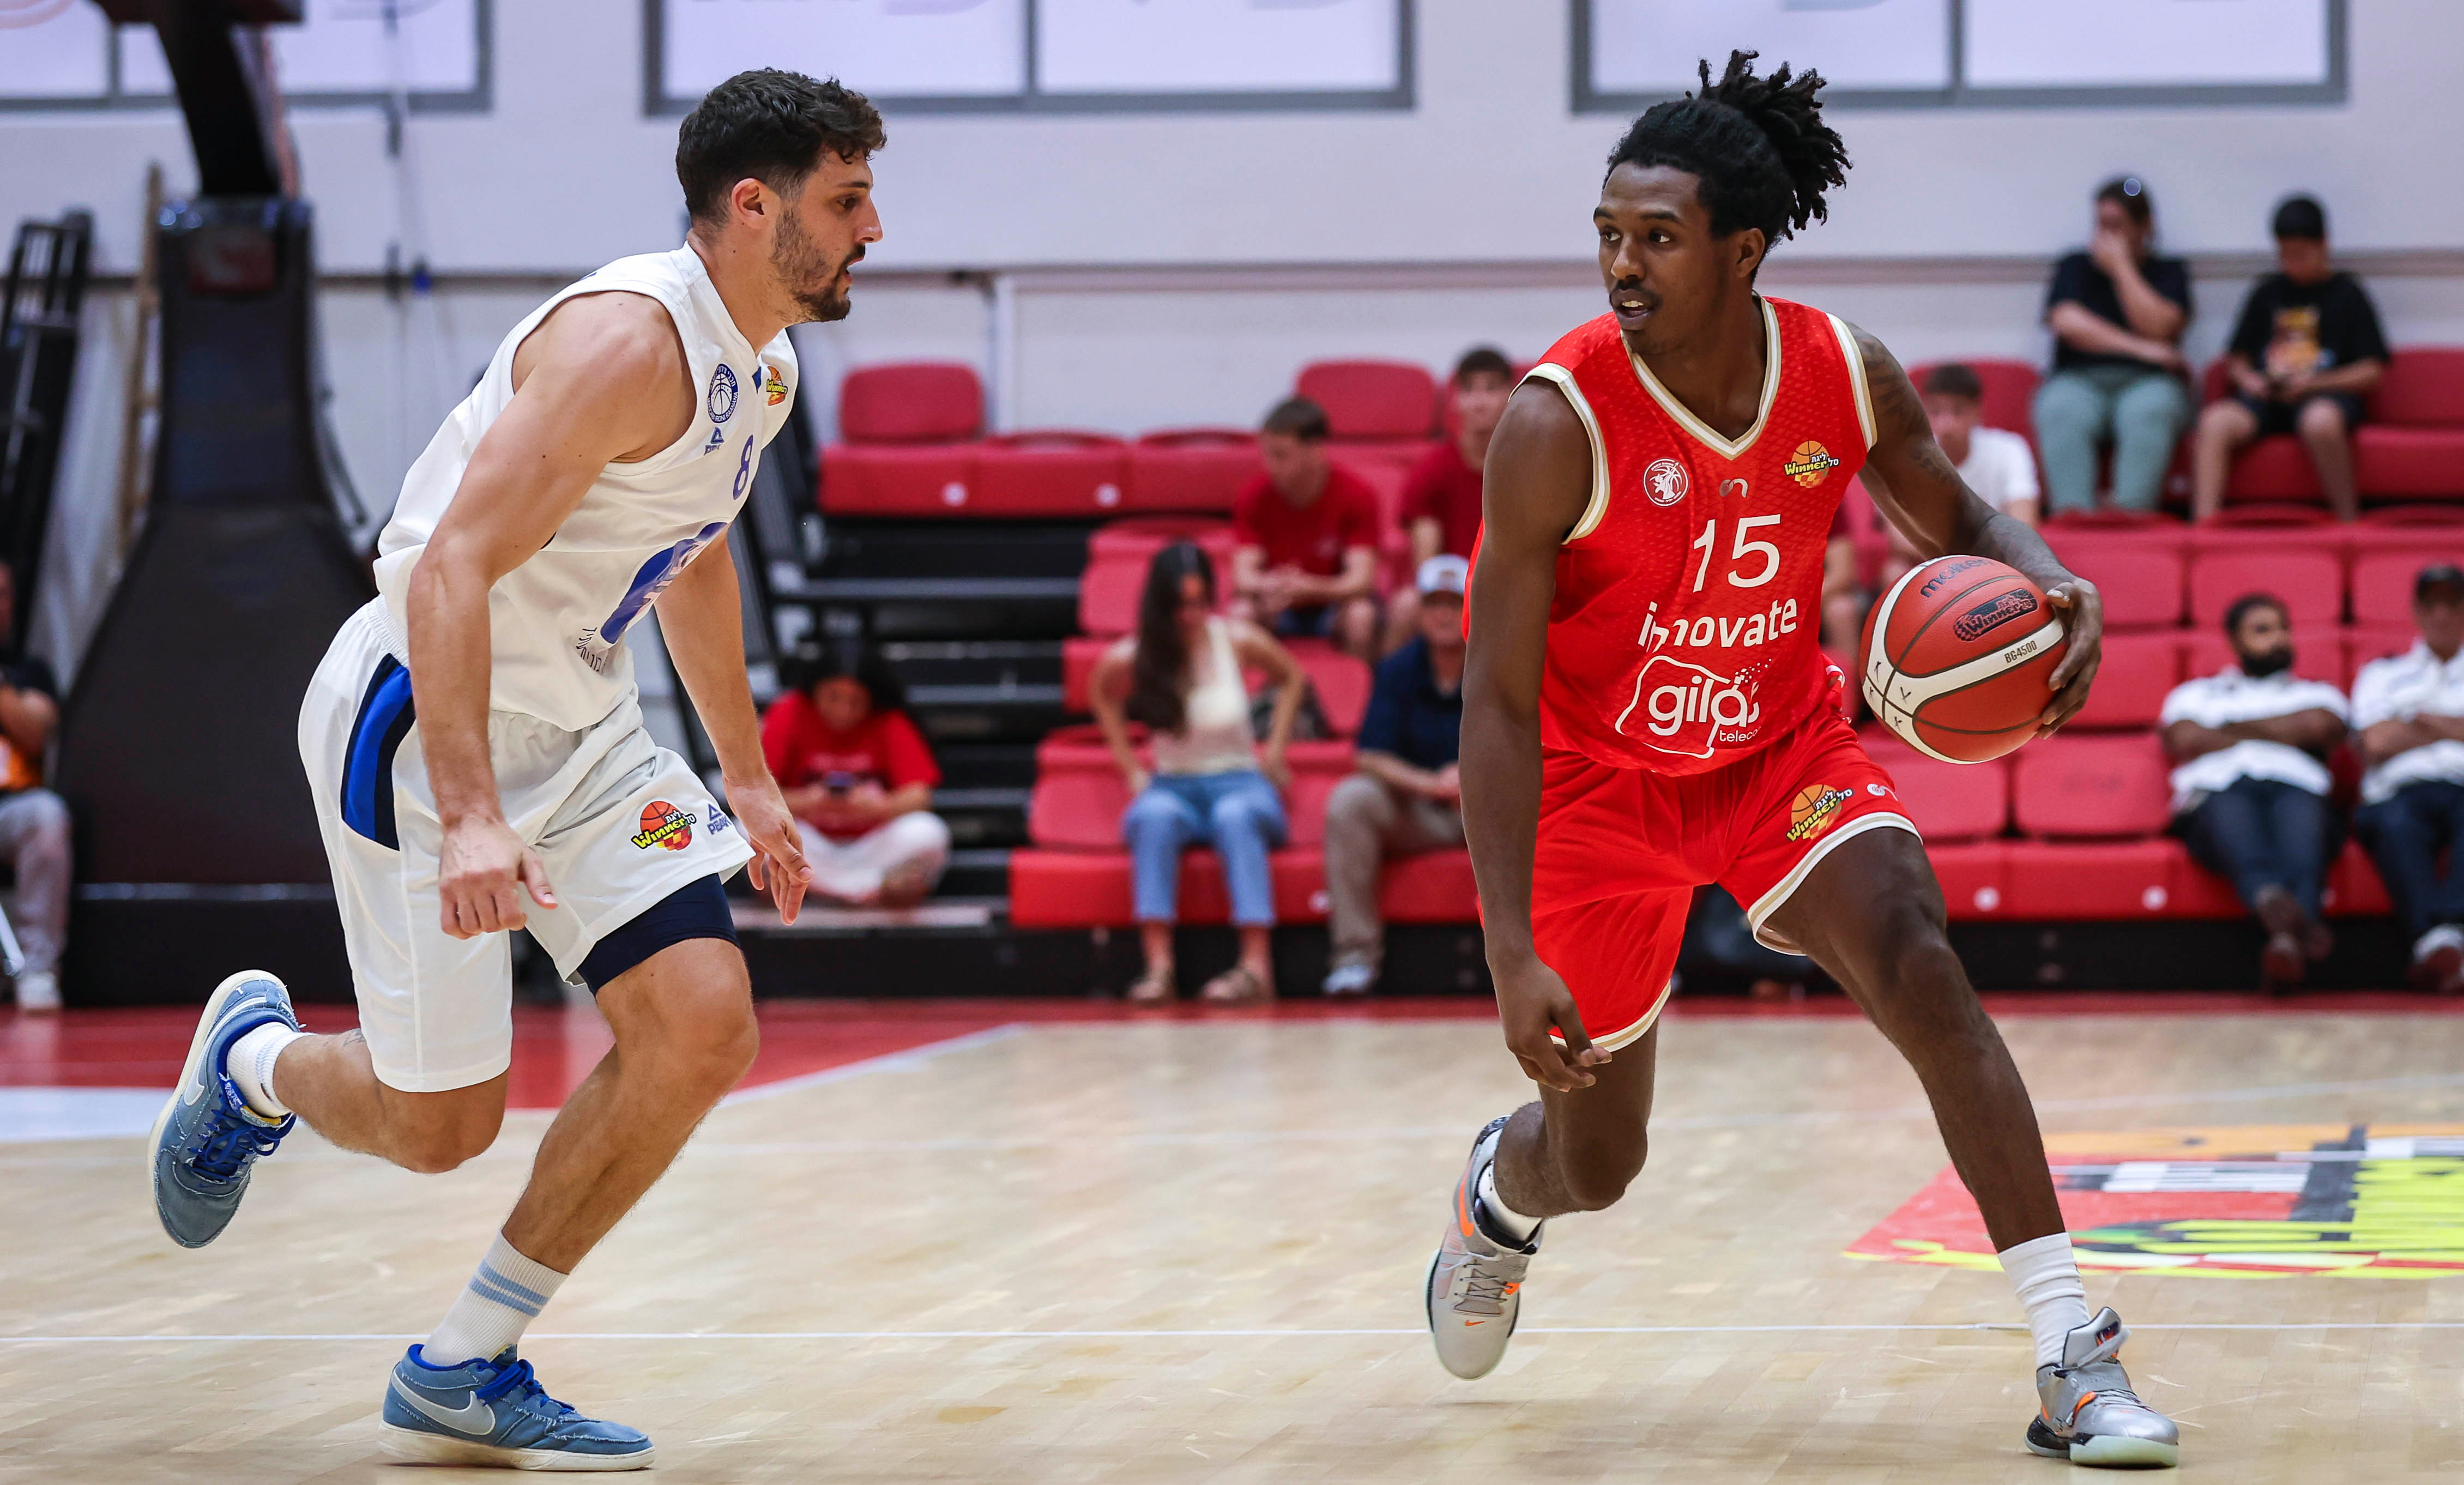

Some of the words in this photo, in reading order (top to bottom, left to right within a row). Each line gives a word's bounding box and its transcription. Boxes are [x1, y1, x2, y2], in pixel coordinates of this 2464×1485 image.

[733, 434, 753, 500] 8
[1784, 461, 1827, 475] Winner
[1692, 514, 1781, 593] 15
[1965, 603, 2022, 632] Winner
[2004, 640, 2037, 663] BG4500
[1719, 726, 1761, 742] teleco
[632, 818, 685, 848] Winner
[1786, 797, 1837, 841] Winner
